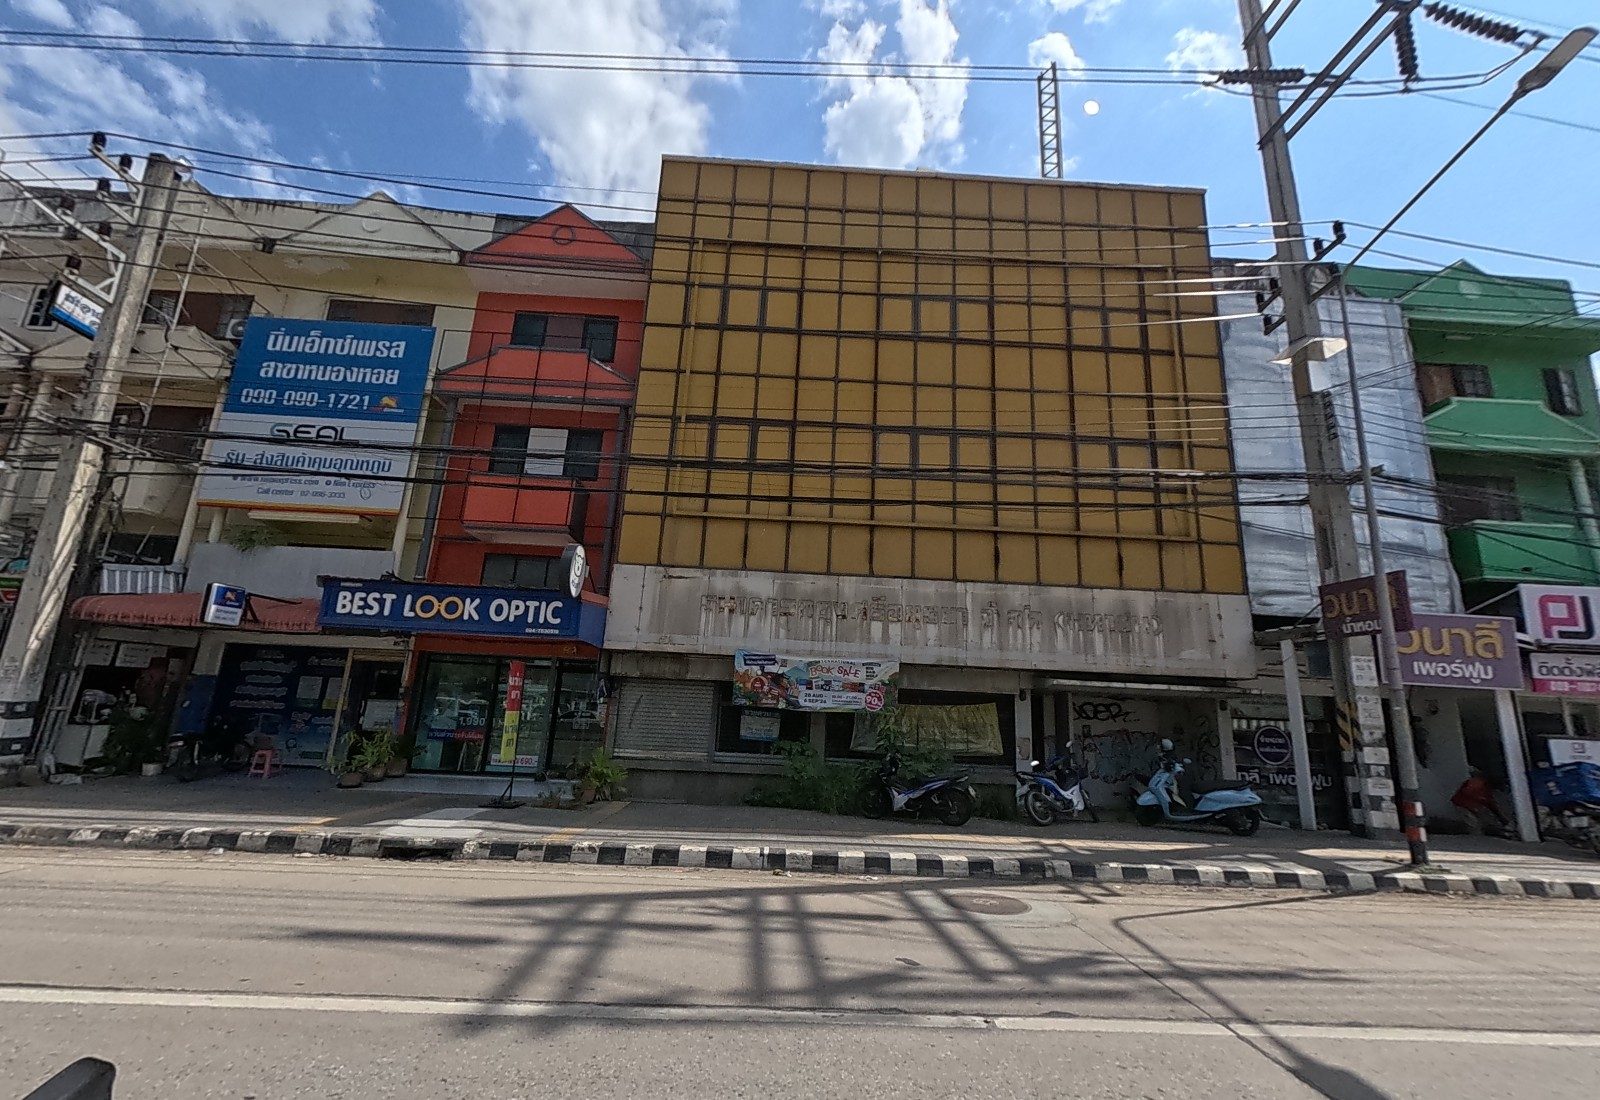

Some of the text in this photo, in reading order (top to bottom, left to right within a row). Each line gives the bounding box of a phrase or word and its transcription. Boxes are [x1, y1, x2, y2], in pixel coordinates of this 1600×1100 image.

[266, 327, 406, 358] นิ่มเอ็กซ์เพรส
[259, 360, 399, 385] สาขาหนองหอย
[240, 388, 370, 410] 090-090-1721
[335, 590, 563, 625] BEST LOOK OPTIC
[810, 664, 861, 678] BOOK SALE
[1412, 659, 1494, 684] เพอร์ฟูม
